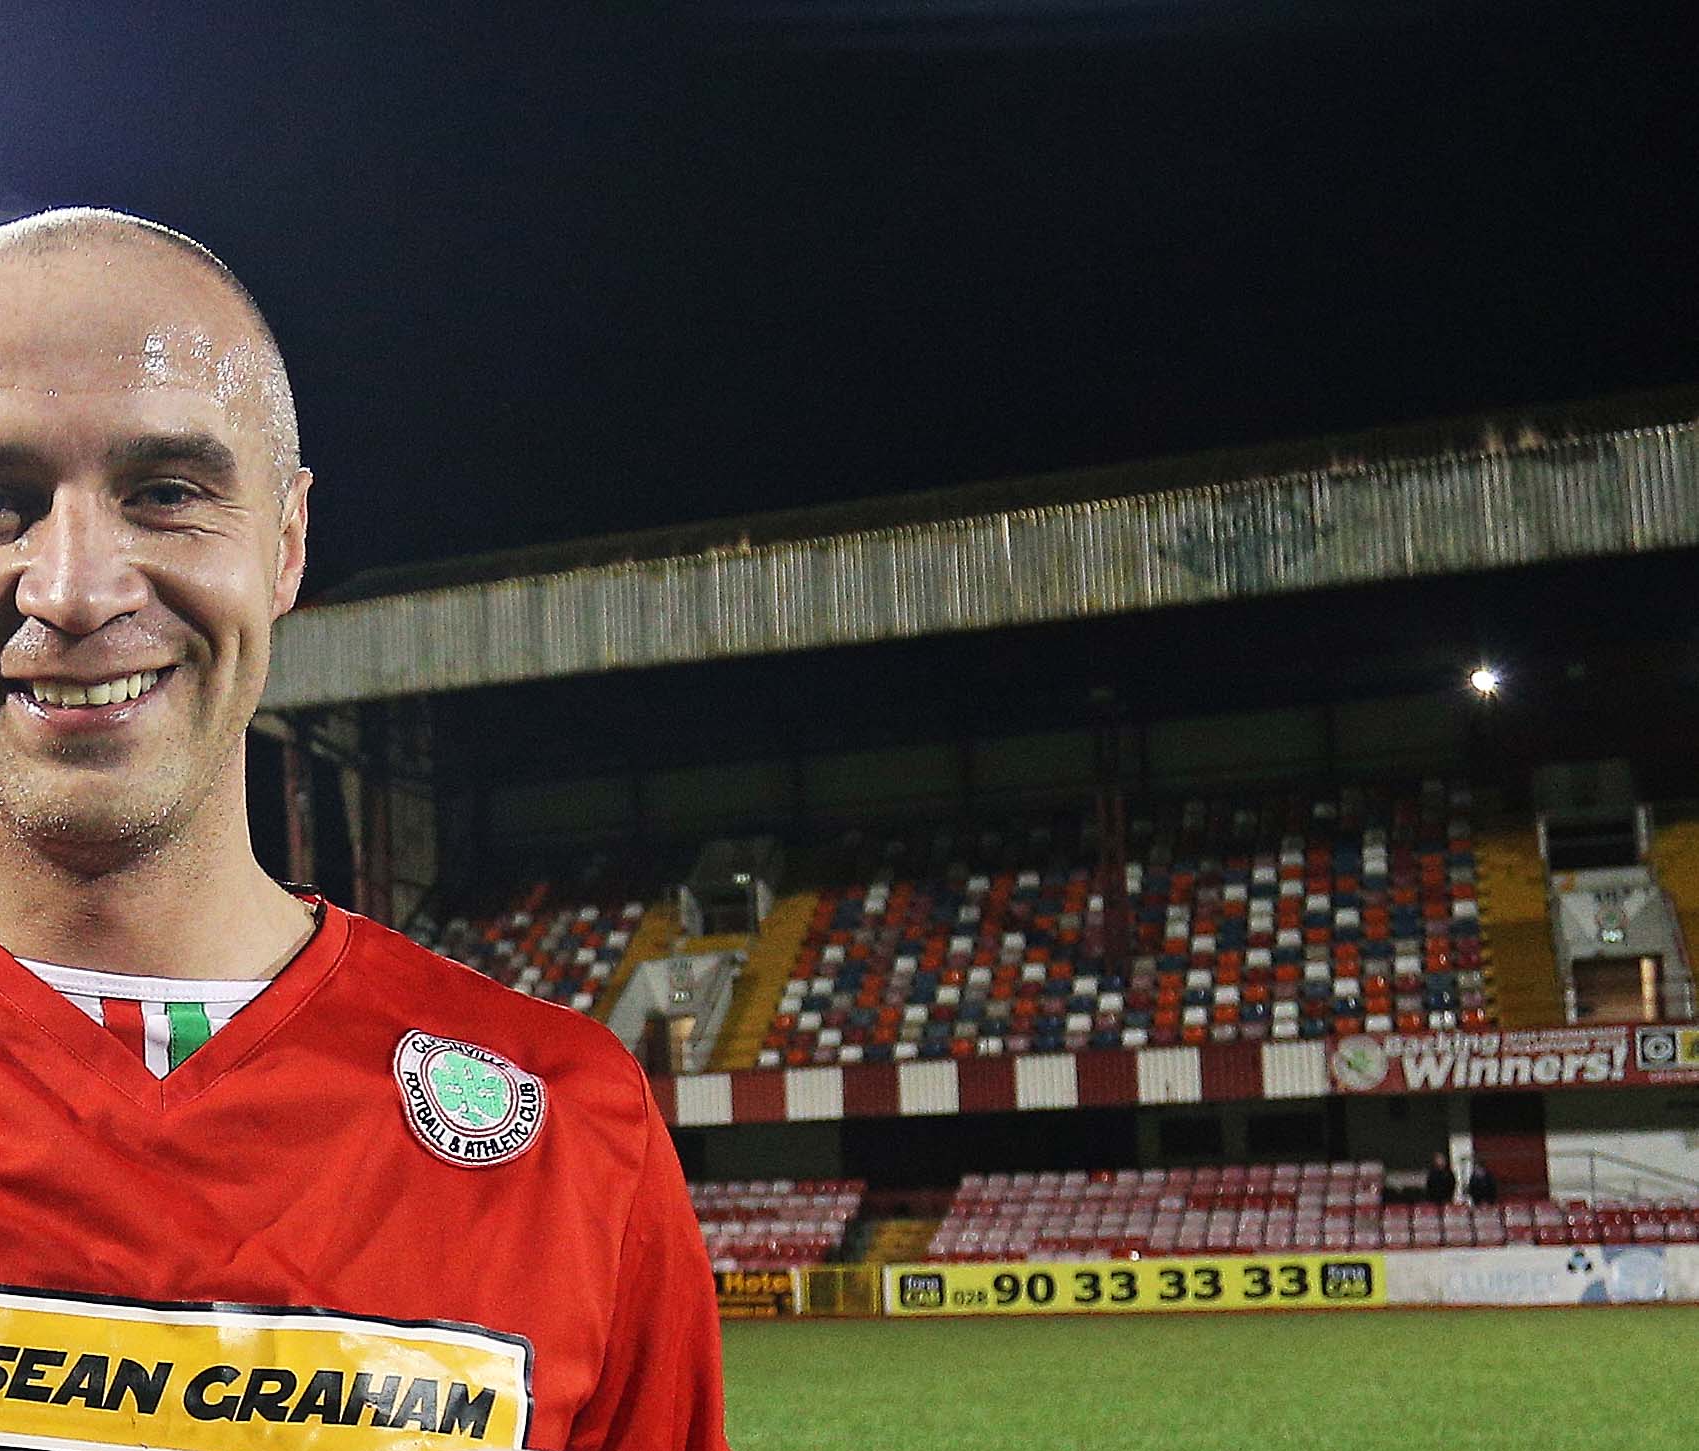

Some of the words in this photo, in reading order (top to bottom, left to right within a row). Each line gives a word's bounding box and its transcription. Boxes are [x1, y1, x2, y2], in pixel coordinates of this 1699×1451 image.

[1401, 1039, 1628, 1091] Winners!
[403, 1071, 445, 1147] FOOTBALL
[448, 1136, 461, 1153] &
[463, 1122, 530, 1158] ATHLETIC
[519, 1082, 538, 1123] CLUB
[992, 1272, 1055, 1305] 90
[1074, 1270, 1138, 1303] 33
[1158, 1267, 1223, 1301] 33
[1242, 1264, 1309, 1298] 33
[182, 1366, 497, 1440] GRAHAM
